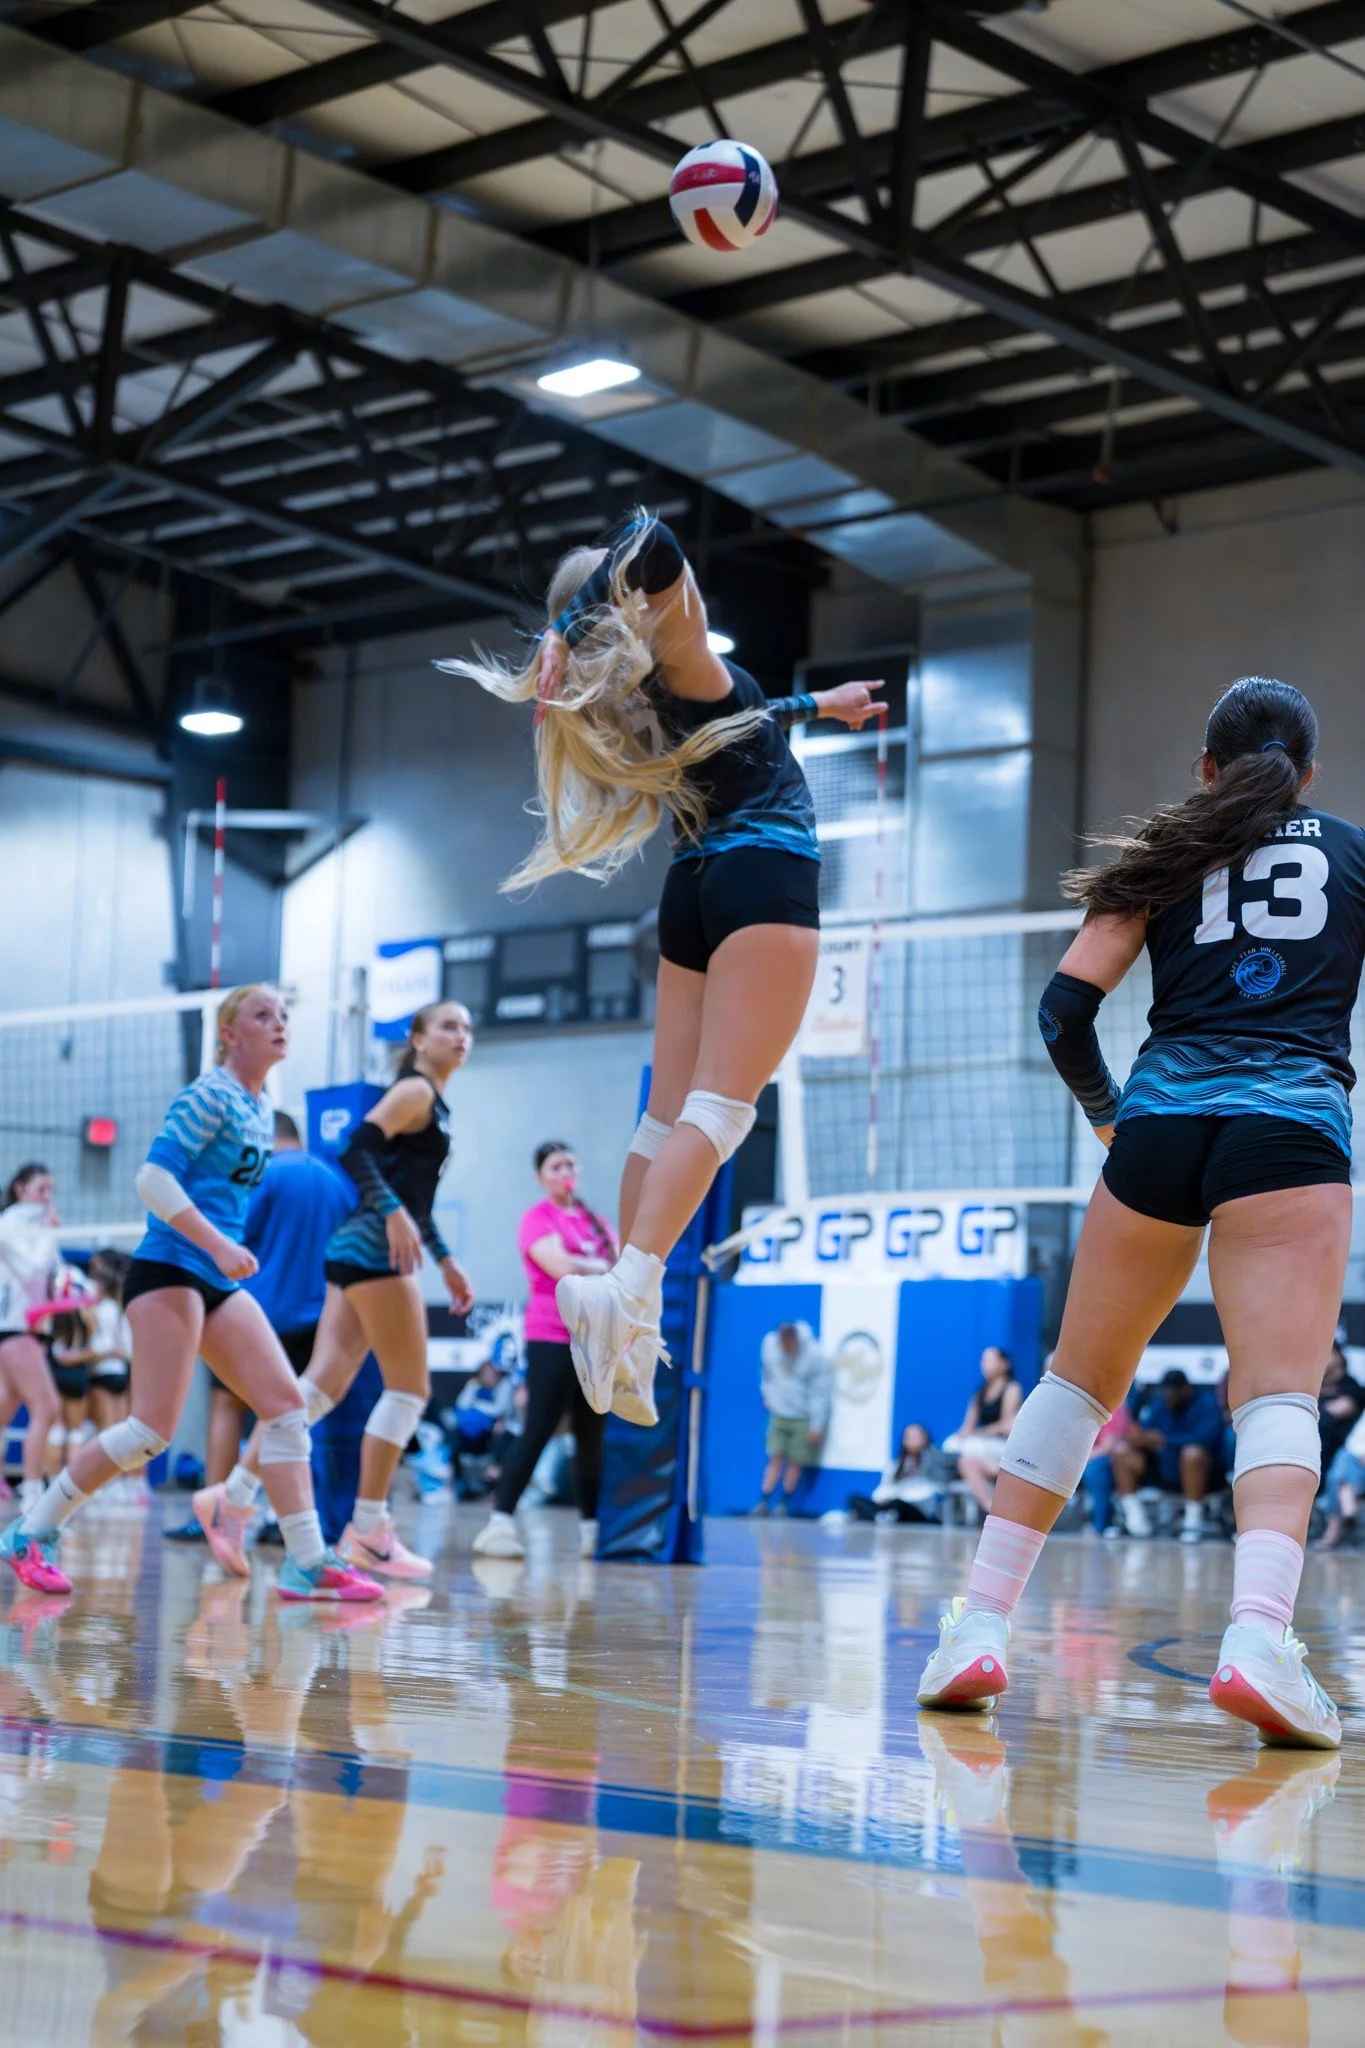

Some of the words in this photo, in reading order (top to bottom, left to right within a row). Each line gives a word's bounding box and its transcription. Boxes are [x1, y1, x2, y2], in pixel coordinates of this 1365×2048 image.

[1194, 843, 1329, 944] 13
[829, 965, 845, 1005] 3
[1230, 961, 1239, 977] CAPE
[1239, 947, 1256, 959] FEAR
[1260, 947, 1287, 976] VOLLEYBALL
[817, 1212, 872, 1261] GP
[886, 1208, 943, 1258] GP
[959, 1206, 1018, 1255] GP
